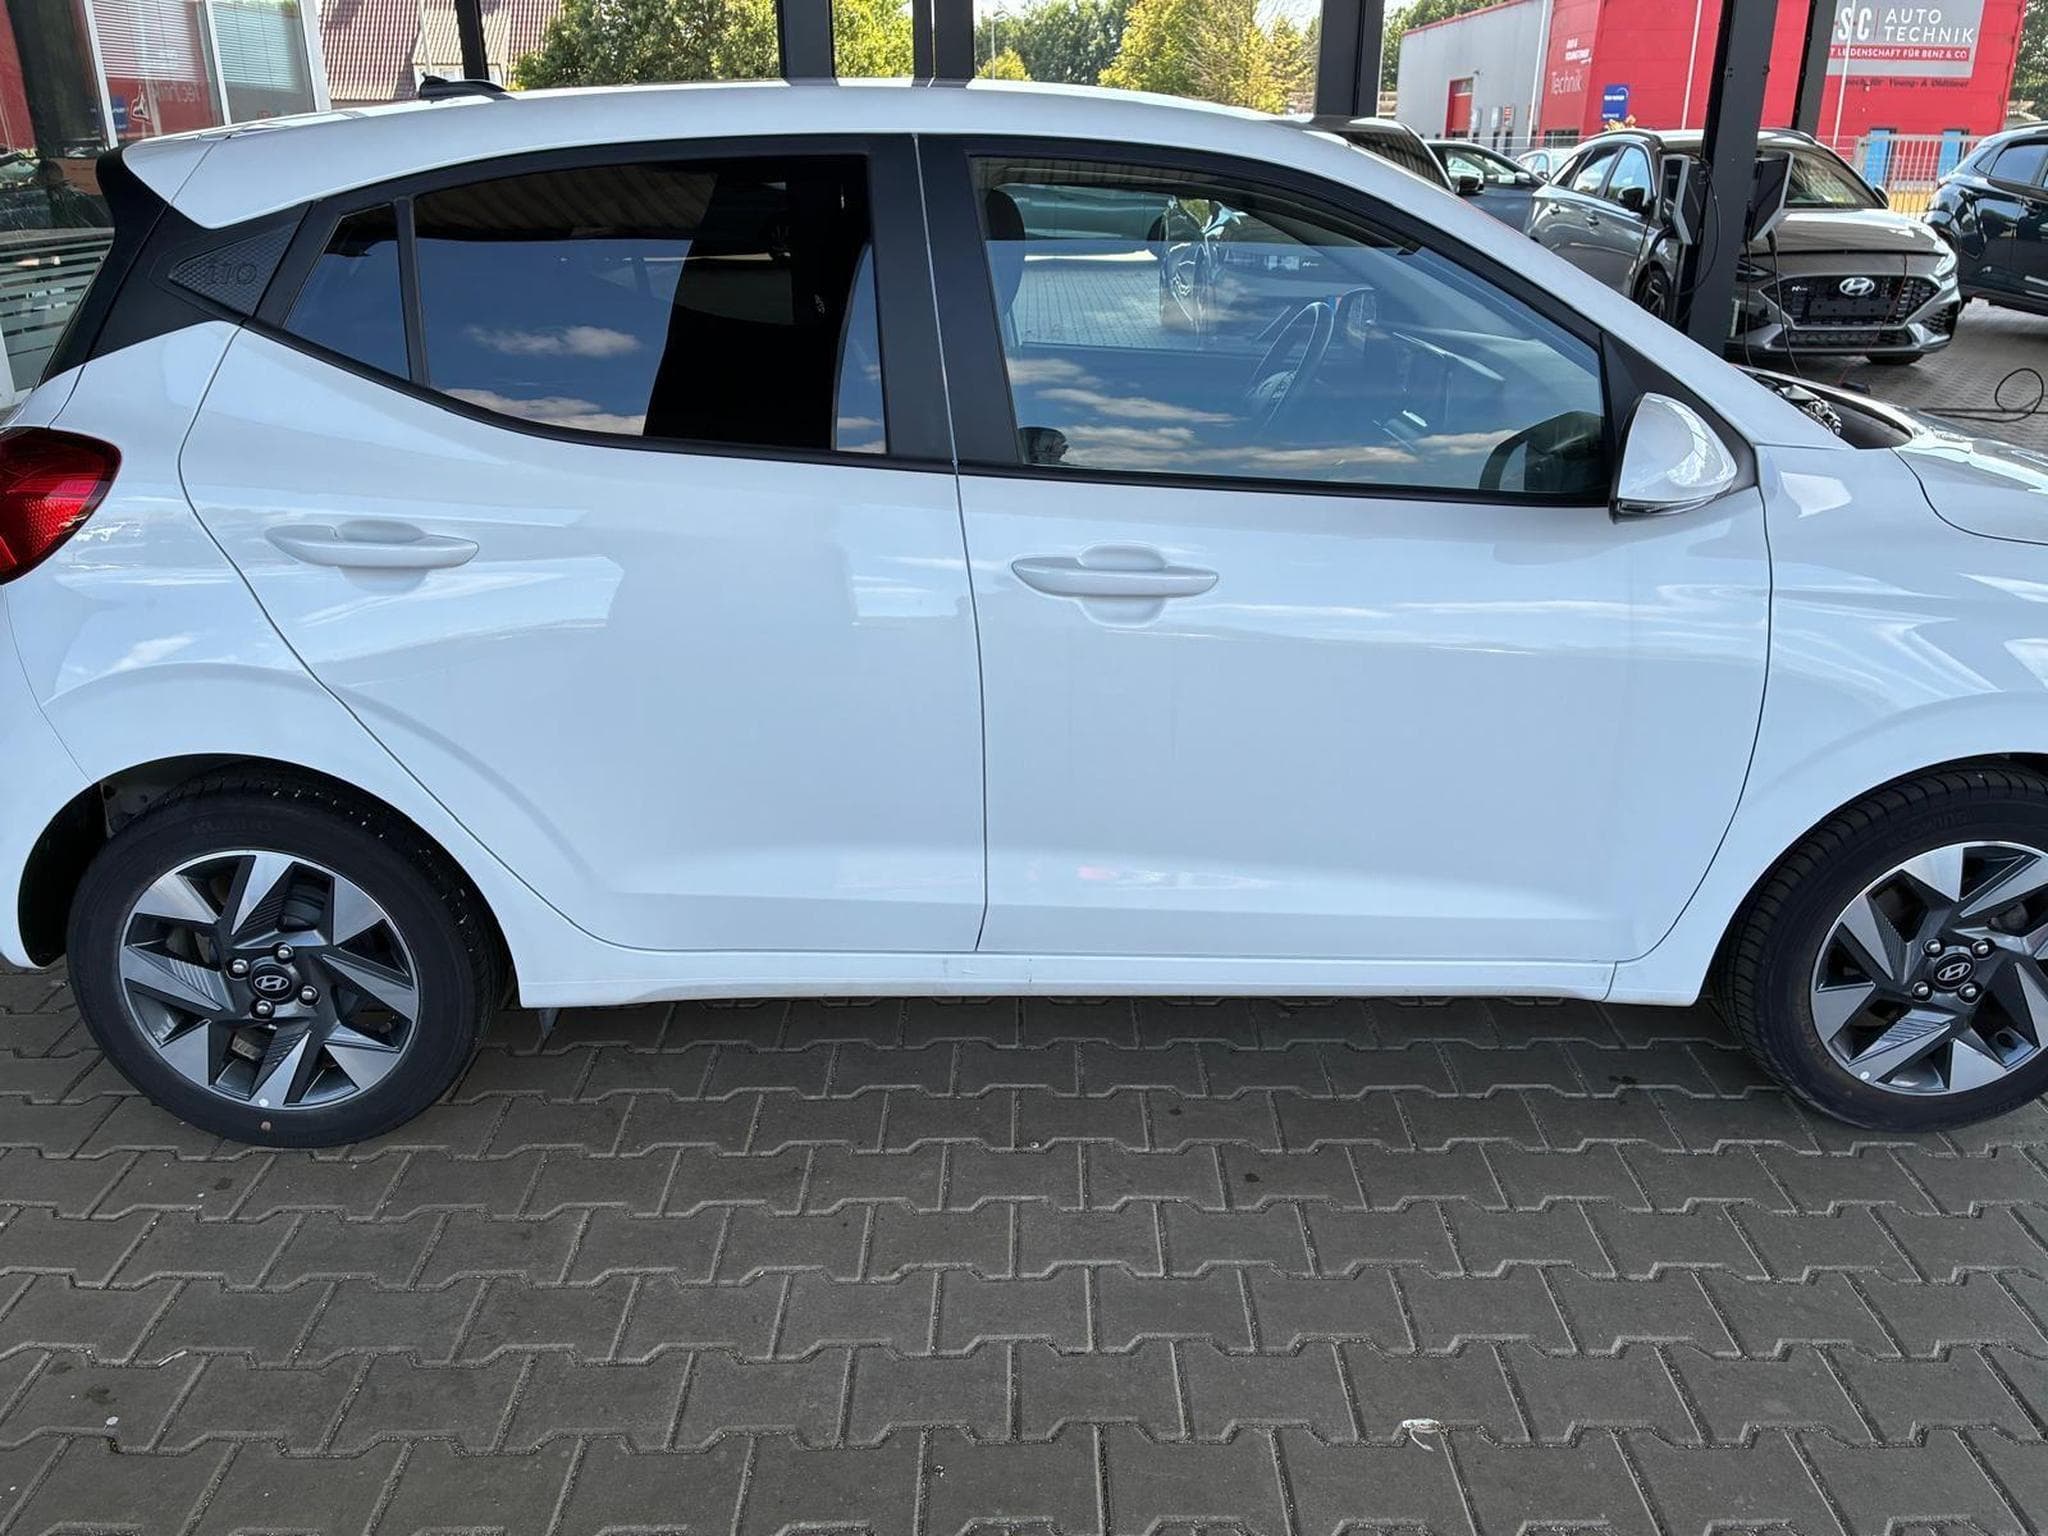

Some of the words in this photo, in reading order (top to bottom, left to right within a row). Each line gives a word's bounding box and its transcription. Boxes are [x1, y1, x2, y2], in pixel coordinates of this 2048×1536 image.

[1885, 8, 1942, 24] AUTO
[1884, 26, 1974, 44] TECHNIK
[1837, 47, 1900, 58] LEDENSCHAFT
[1921, 49, 1944, 58] BENZ
[1551, 69, 1584, 95] Technik
